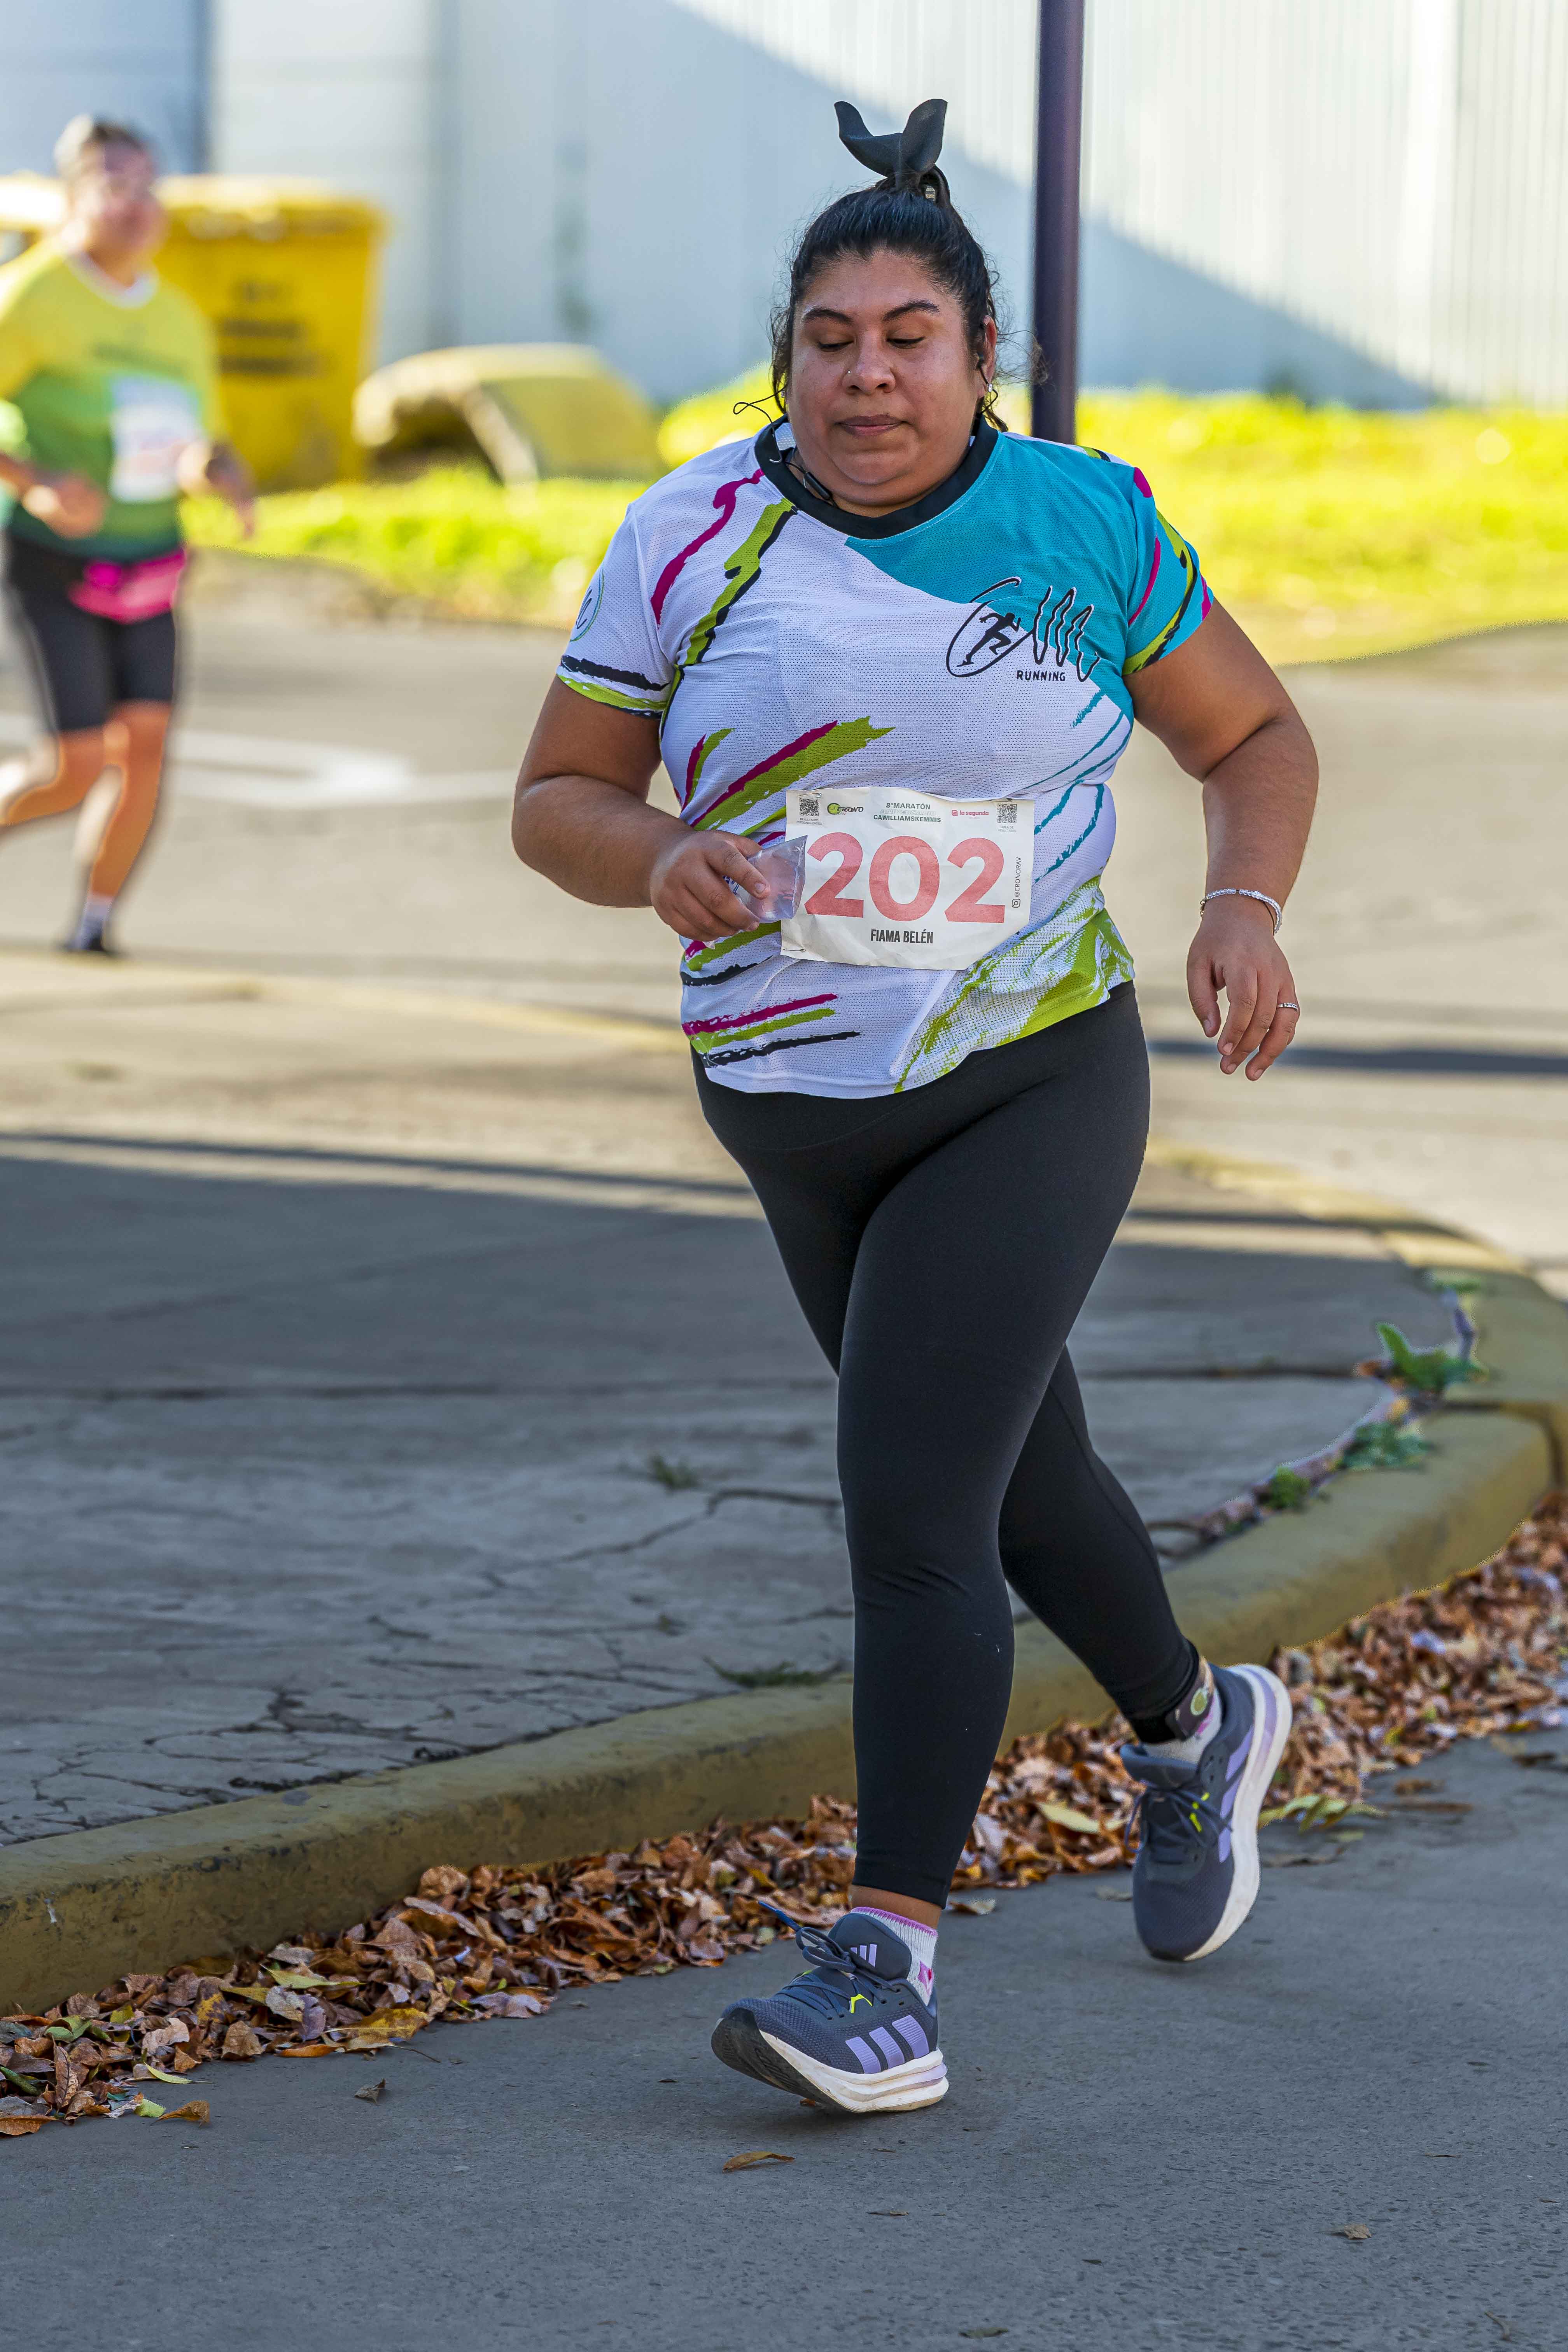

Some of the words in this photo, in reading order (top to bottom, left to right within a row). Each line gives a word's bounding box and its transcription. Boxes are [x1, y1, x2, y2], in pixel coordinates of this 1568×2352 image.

[1017, 670, 1066, 681] RUNNING
[804, 832, 1005, 923] 202
[871, 929, 900, 942] FIAMA
[903, 929, 933, 943] BELÉN
